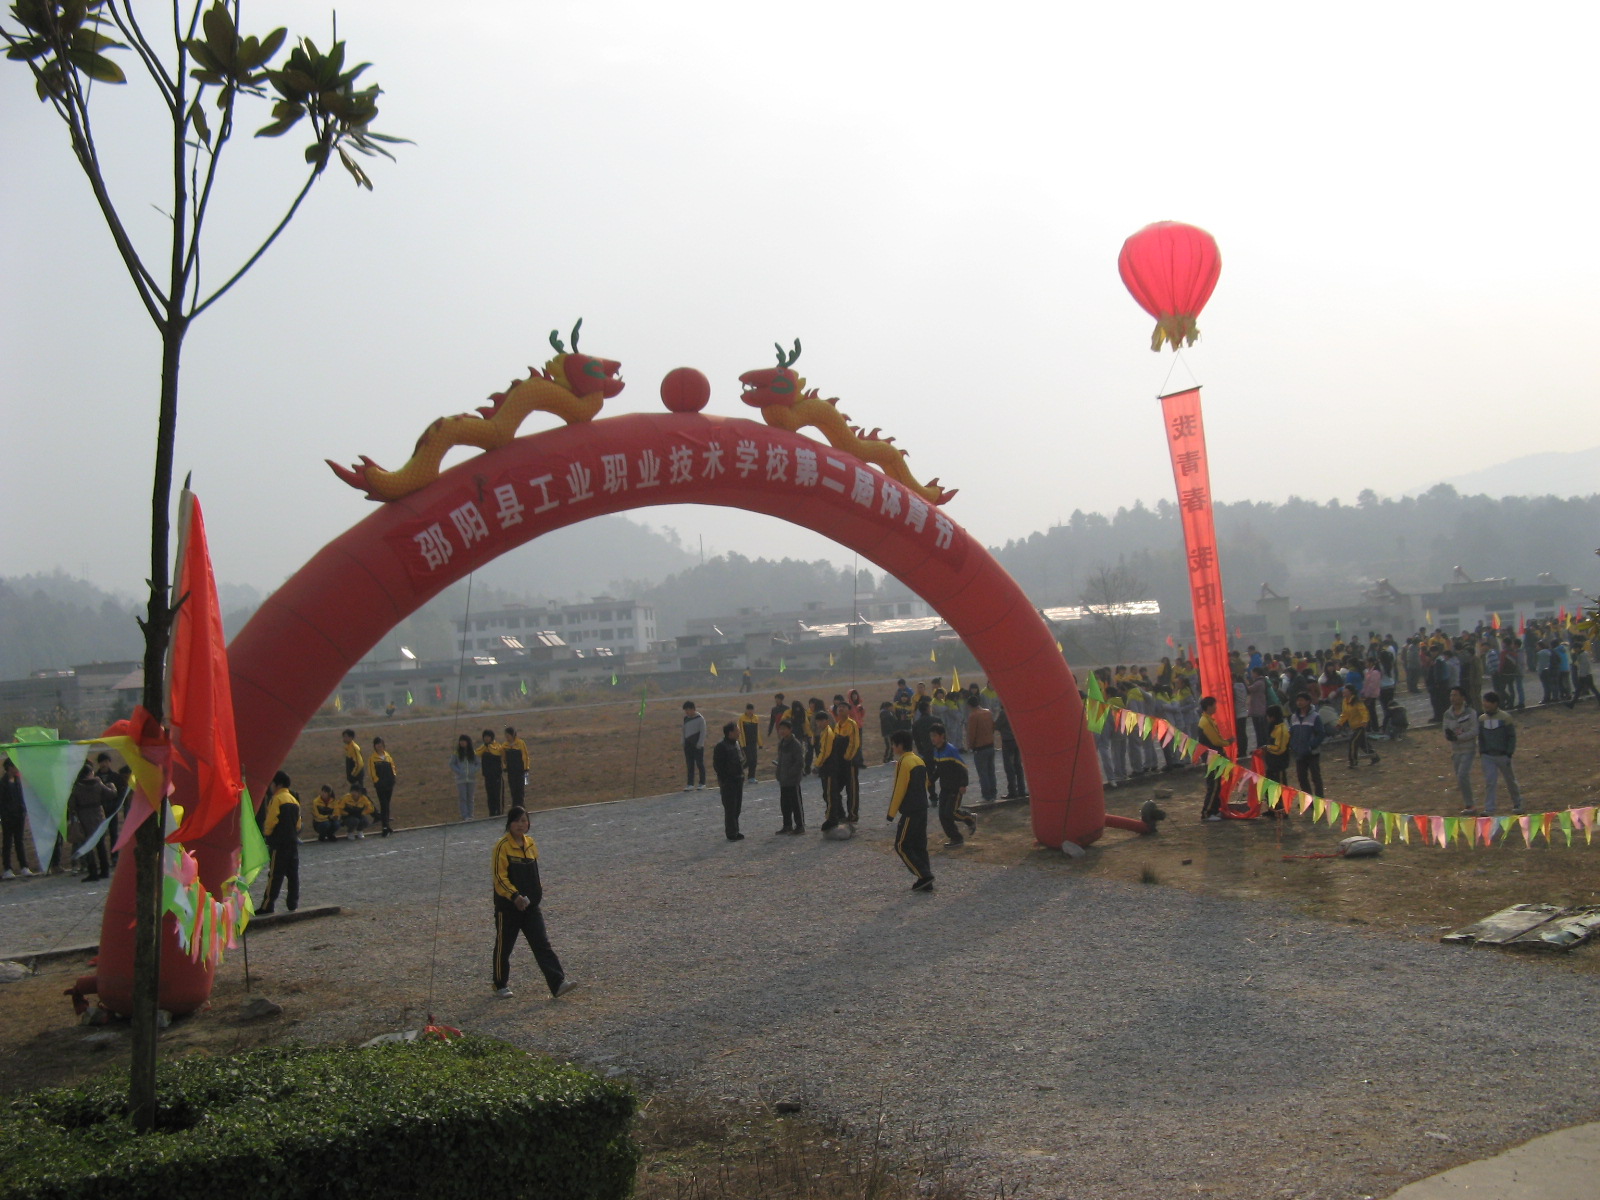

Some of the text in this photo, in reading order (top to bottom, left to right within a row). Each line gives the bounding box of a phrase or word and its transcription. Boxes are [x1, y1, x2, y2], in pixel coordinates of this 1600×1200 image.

[413, 440, 954, 571] 邵阳县工业职业技术学校第二届体育节
